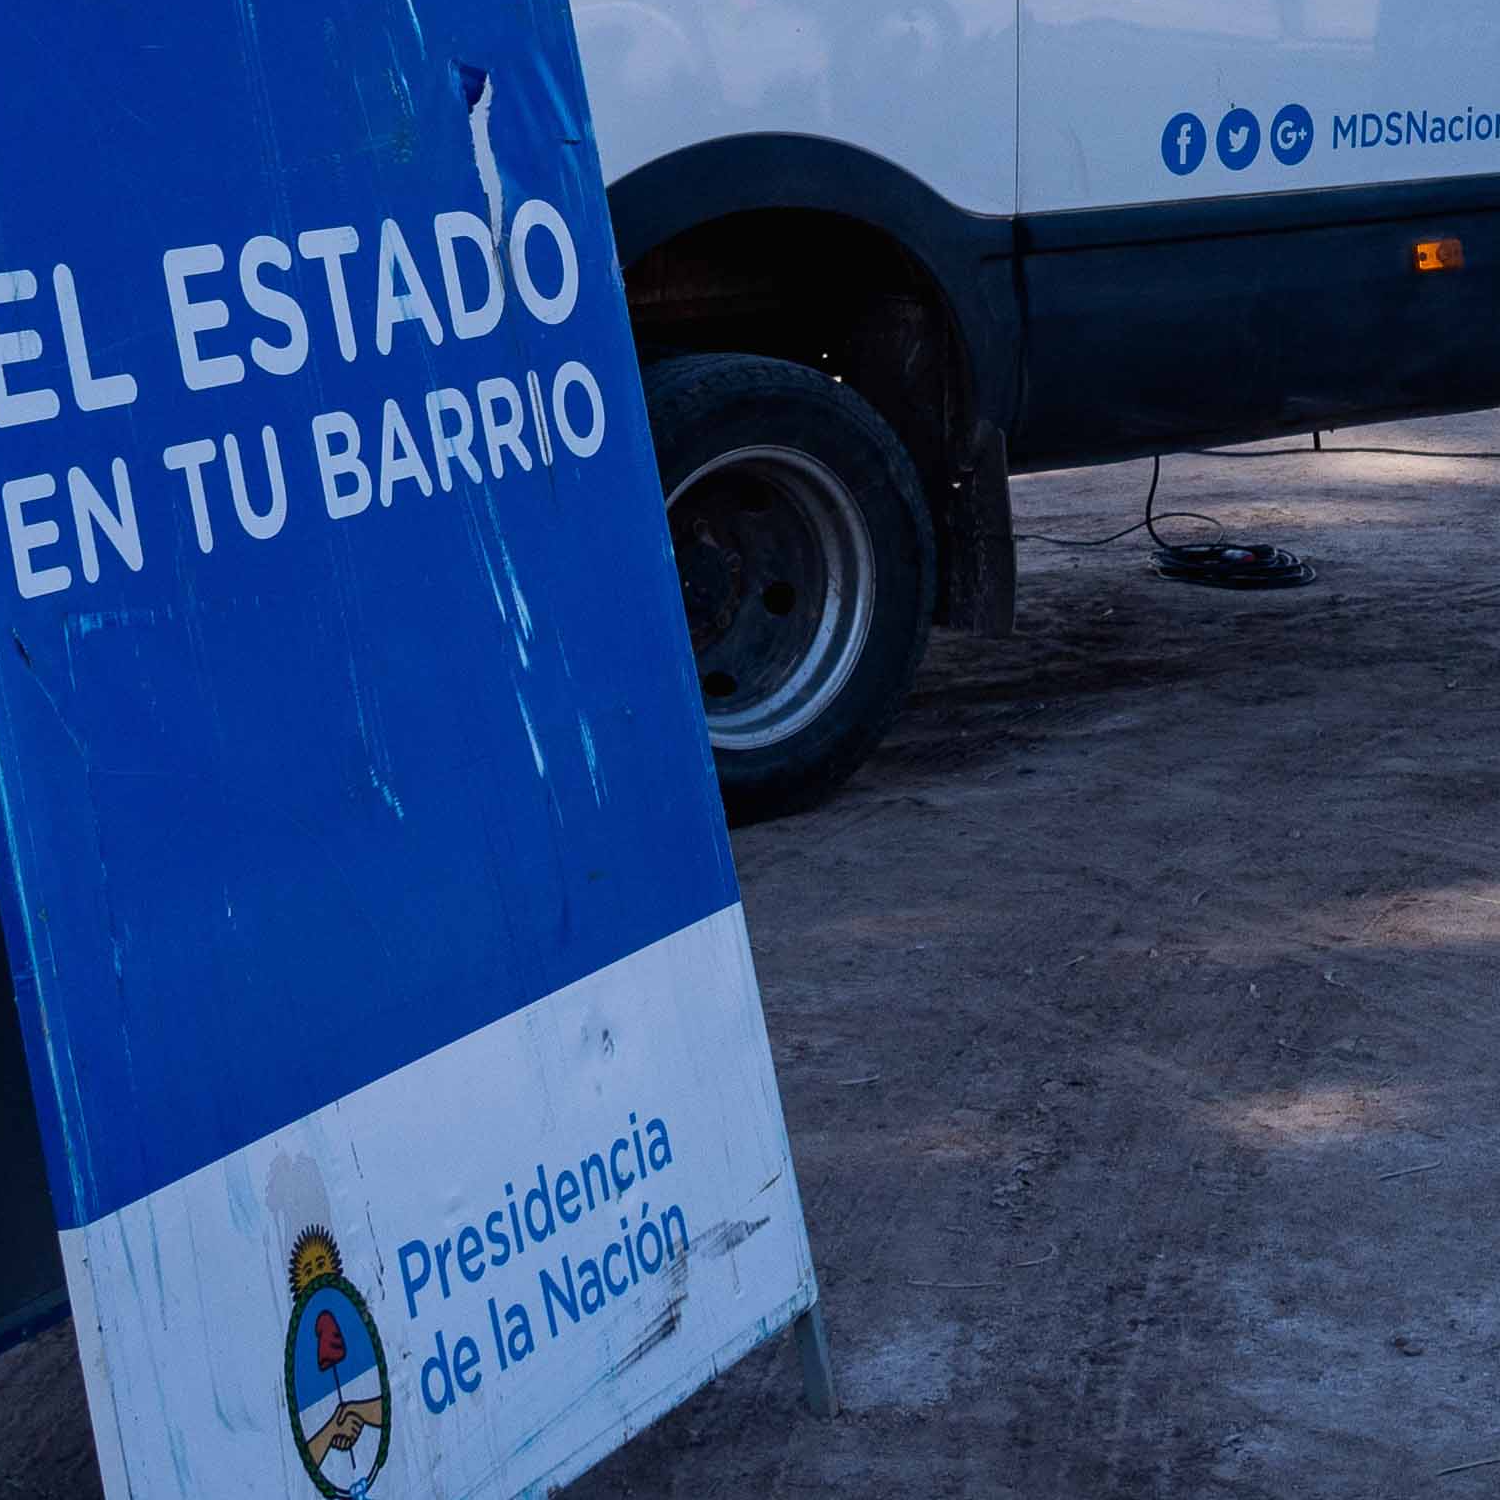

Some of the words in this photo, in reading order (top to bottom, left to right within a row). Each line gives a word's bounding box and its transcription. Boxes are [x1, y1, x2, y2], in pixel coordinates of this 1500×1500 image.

[162, 199, 580, 391] ESTADO
[1, 456, 144, 600] EN
[162, 425, 289, 553] TU
[311, 360, 606, 520] BARRIO
[397, 1111, 674, 1319] Presidencia
[420, 1331, 482, 1415] de
[487, 1297, 535, 1371] la
[539, 1201, 690, 1338] Nación
